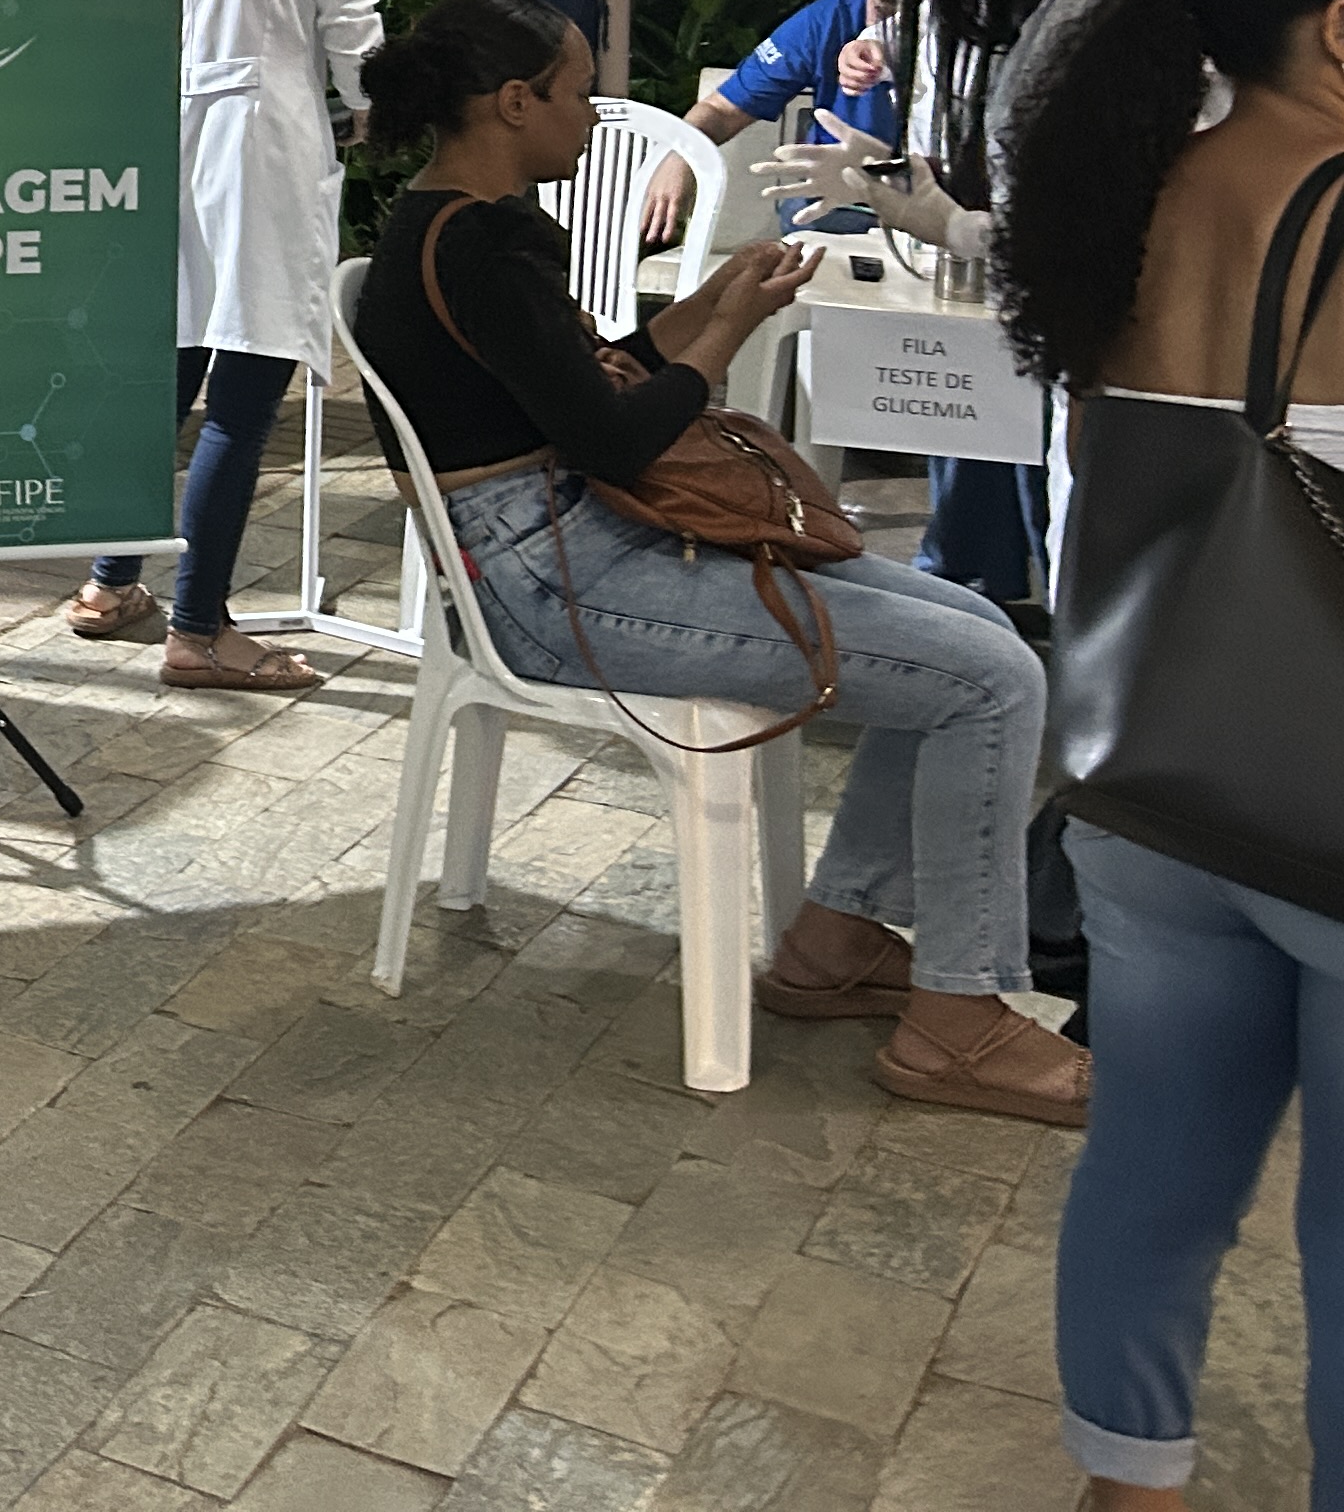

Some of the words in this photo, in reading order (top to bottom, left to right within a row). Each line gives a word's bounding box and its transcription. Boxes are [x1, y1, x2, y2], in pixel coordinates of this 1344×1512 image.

[902, 337, 947, 357] FILA
[875, 366, 938, 388] TESTE
[945, 373, 973, 391] DE
[872, 395, 978, 421] GLICEMIA
